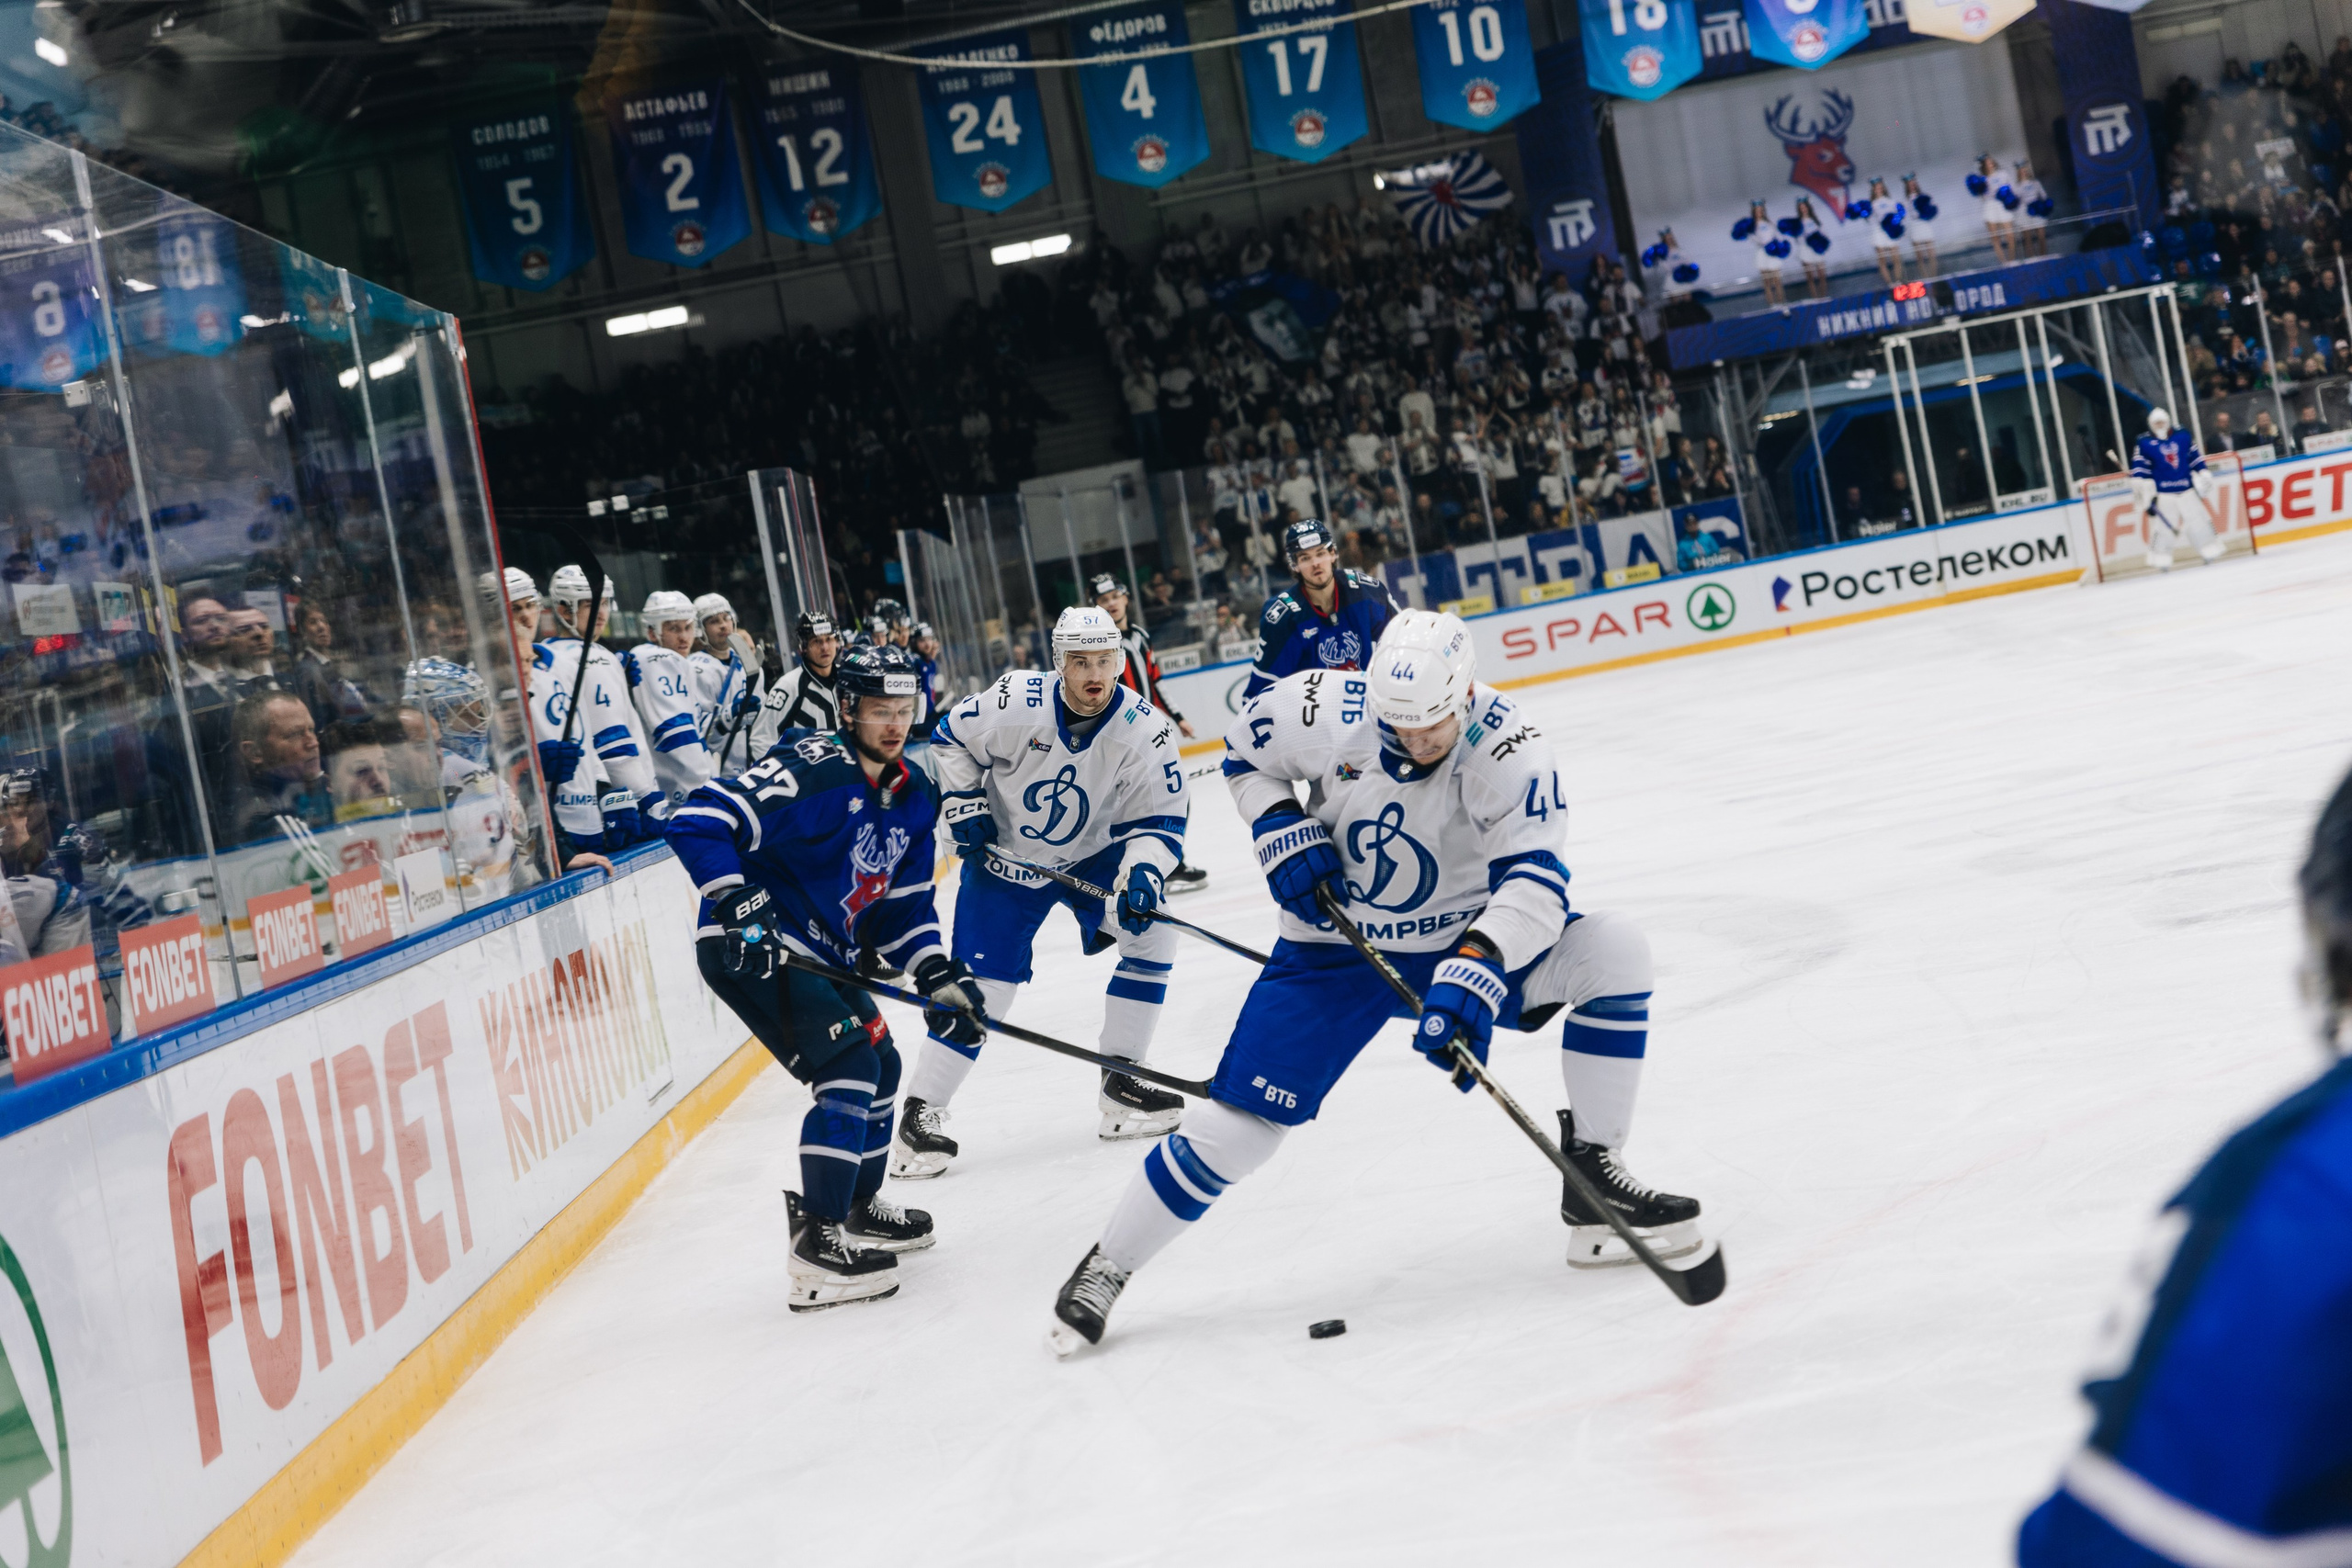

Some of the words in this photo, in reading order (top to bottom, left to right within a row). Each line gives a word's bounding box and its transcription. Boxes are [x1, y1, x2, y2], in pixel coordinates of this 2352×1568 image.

[1438, 6, 1505, 67] 10
[1267, 35, 1329, 96] 17
[1120, 63, 1157, 119] 4
[948, 95, 1022, 154] 24
[776, 127, 850, 192] 12
[662, 152, 700, 213] 2
[504, 176, 543, 236] 5
[1905, 282, 2007, 321] НООРОД
[2104, 462, 2352, 556] FNBET
[1802, 534, 2070, 606] Ростелеком
[1083, 615, 1099, 626] 57
[1502, 601, 1671, 660] SPAR
[1080, 636, 1108, 644] согаз
[658, 673, 688, 697] 34
[886, 679, 915, 689] согаз
[1391, 661, 1415, 681] 44
[594, 683, 611, 707] 4
[765, 691, 787, 710] 66
[1026, 677, 1043, 708] ВТБ
[1135, 697, 1155, 716] ВТ
[1341, 680, 1366, 725] ВТБ
[1384, 711, 1421, 722] согаз
[1482, 694, 1517, 731] ВТ
[1151, 720, 1173, 749] RW
[737, 756, 799, 803] 27
[1162, 760, 1183, 795] 5
[944, 802, 990, 820] CCM
[1258, 824, 1329, 868] WARRIO
[989, 856, 1045, 881] OLIM
[735, 887, 771, 920] BAU
[1080, 884, 1113, 900] BAU
[334, 878, 390, 945] FONBET
[254, 899, 320, 974] FONBET
[127, 931, 207, 1017] FONBET
[3, 964, 99, 1063] FONBET
[1120, 1090, 1143, 1103] BAUER
[1264, 1084, 1297, 1110] ВТБ
[167, 998, 474, 1469] FONBET
[864, 1228, 892, 1238] BAUER
